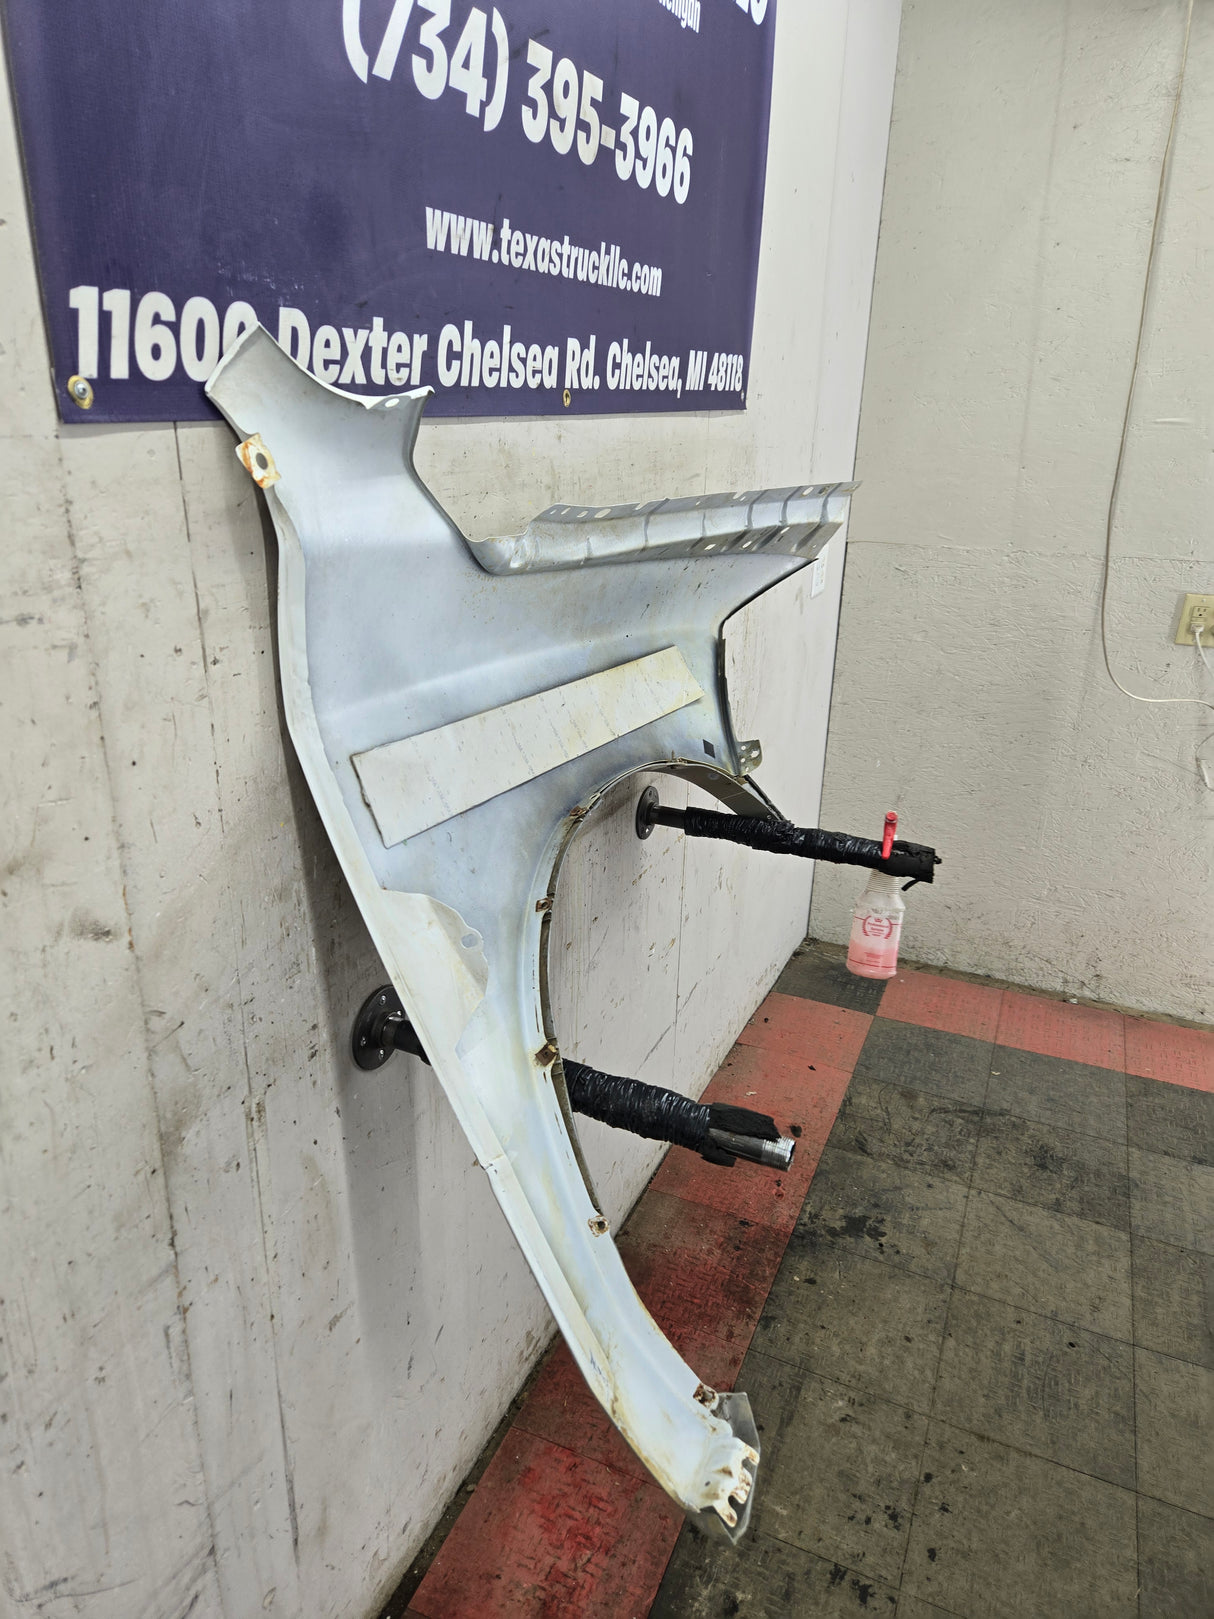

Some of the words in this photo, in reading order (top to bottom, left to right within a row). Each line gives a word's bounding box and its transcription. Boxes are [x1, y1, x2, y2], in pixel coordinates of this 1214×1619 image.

[522, 39, 693, 204] 395-3966
[426, 207, 662, 296] www.texastruckllc.com
[278, 307, 428, 386] Dexter
[437, 320, 558, 389] Chelsea
[564, 335, 600, 389] Rd.
[607, 339, 682, 398] Chelsea,
[686, 350, 707, 391] MI
[707, 352, 744, 391] 48118
